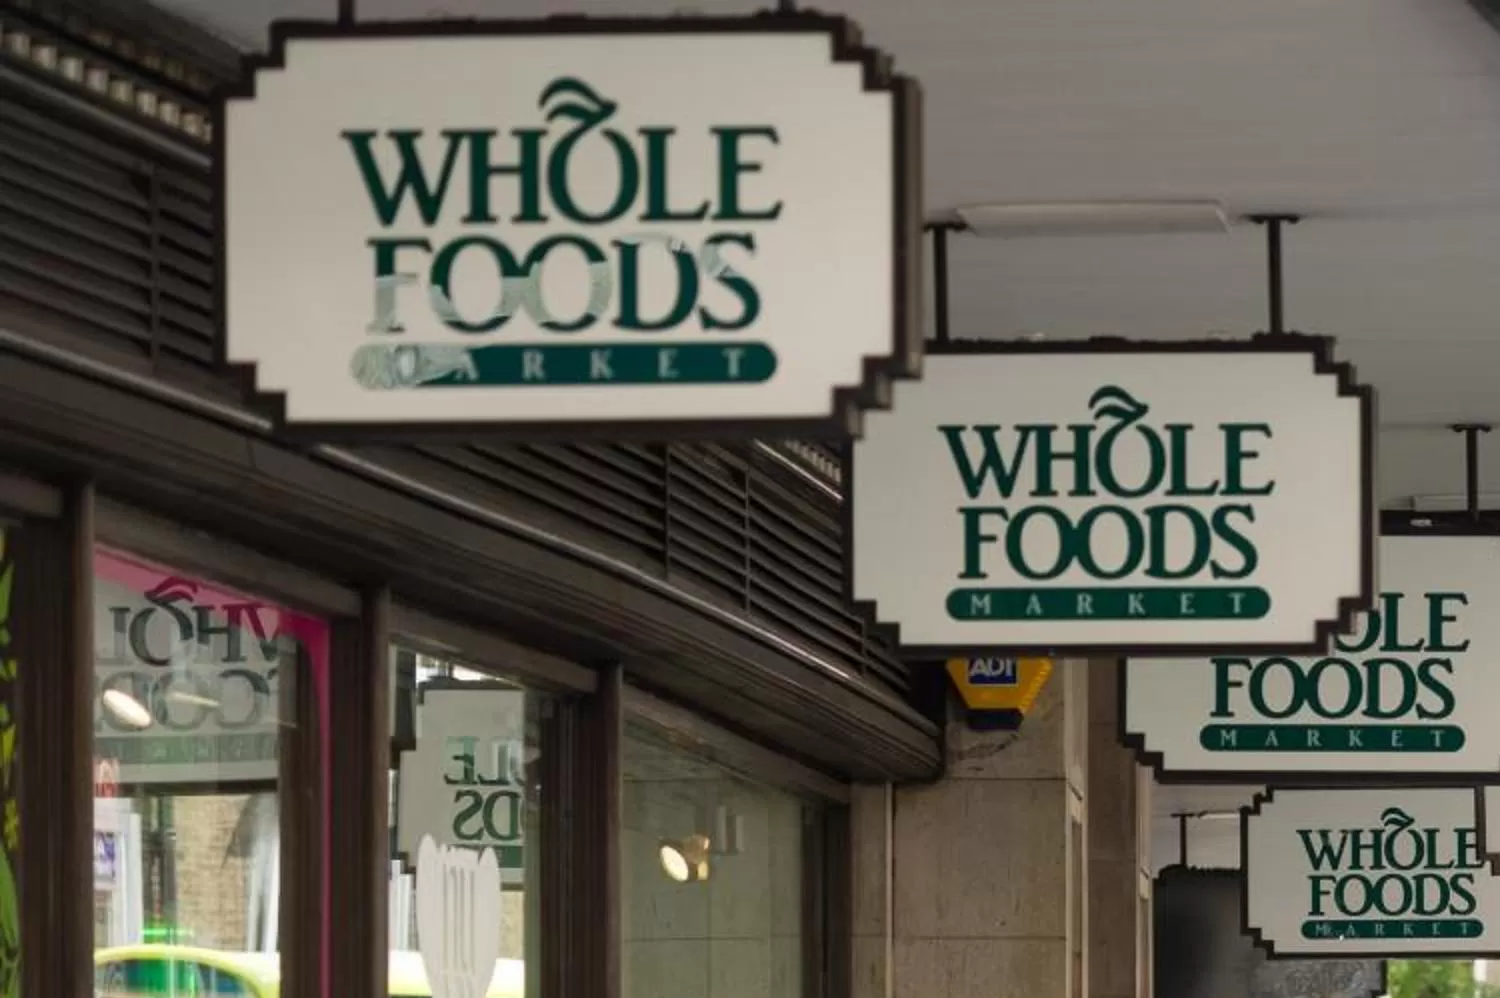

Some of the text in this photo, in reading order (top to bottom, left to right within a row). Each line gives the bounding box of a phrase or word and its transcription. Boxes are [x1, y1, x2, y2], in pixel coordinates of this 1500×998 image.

[341, 76, 783, 226] WHOLE
[367, 233, 761, 333] FOODS
[385, 346, 747, 381] ARKET
[937, 385, 1275, 498] WHOLE
[957, 504, 1258, 580] FOODS
[970, 592, 1246, 614] MARKET
[1333, 592, 1470, 652] OLE
[1210, 656, 1456, 719] FOODS
[1220, 729, 1448, 747] MARKET
[1296, 807, 1485, 870] WHOLE
[1307, 873, 1477, 916] FOODS
[1315, 921, 1470, 937] MARKET
